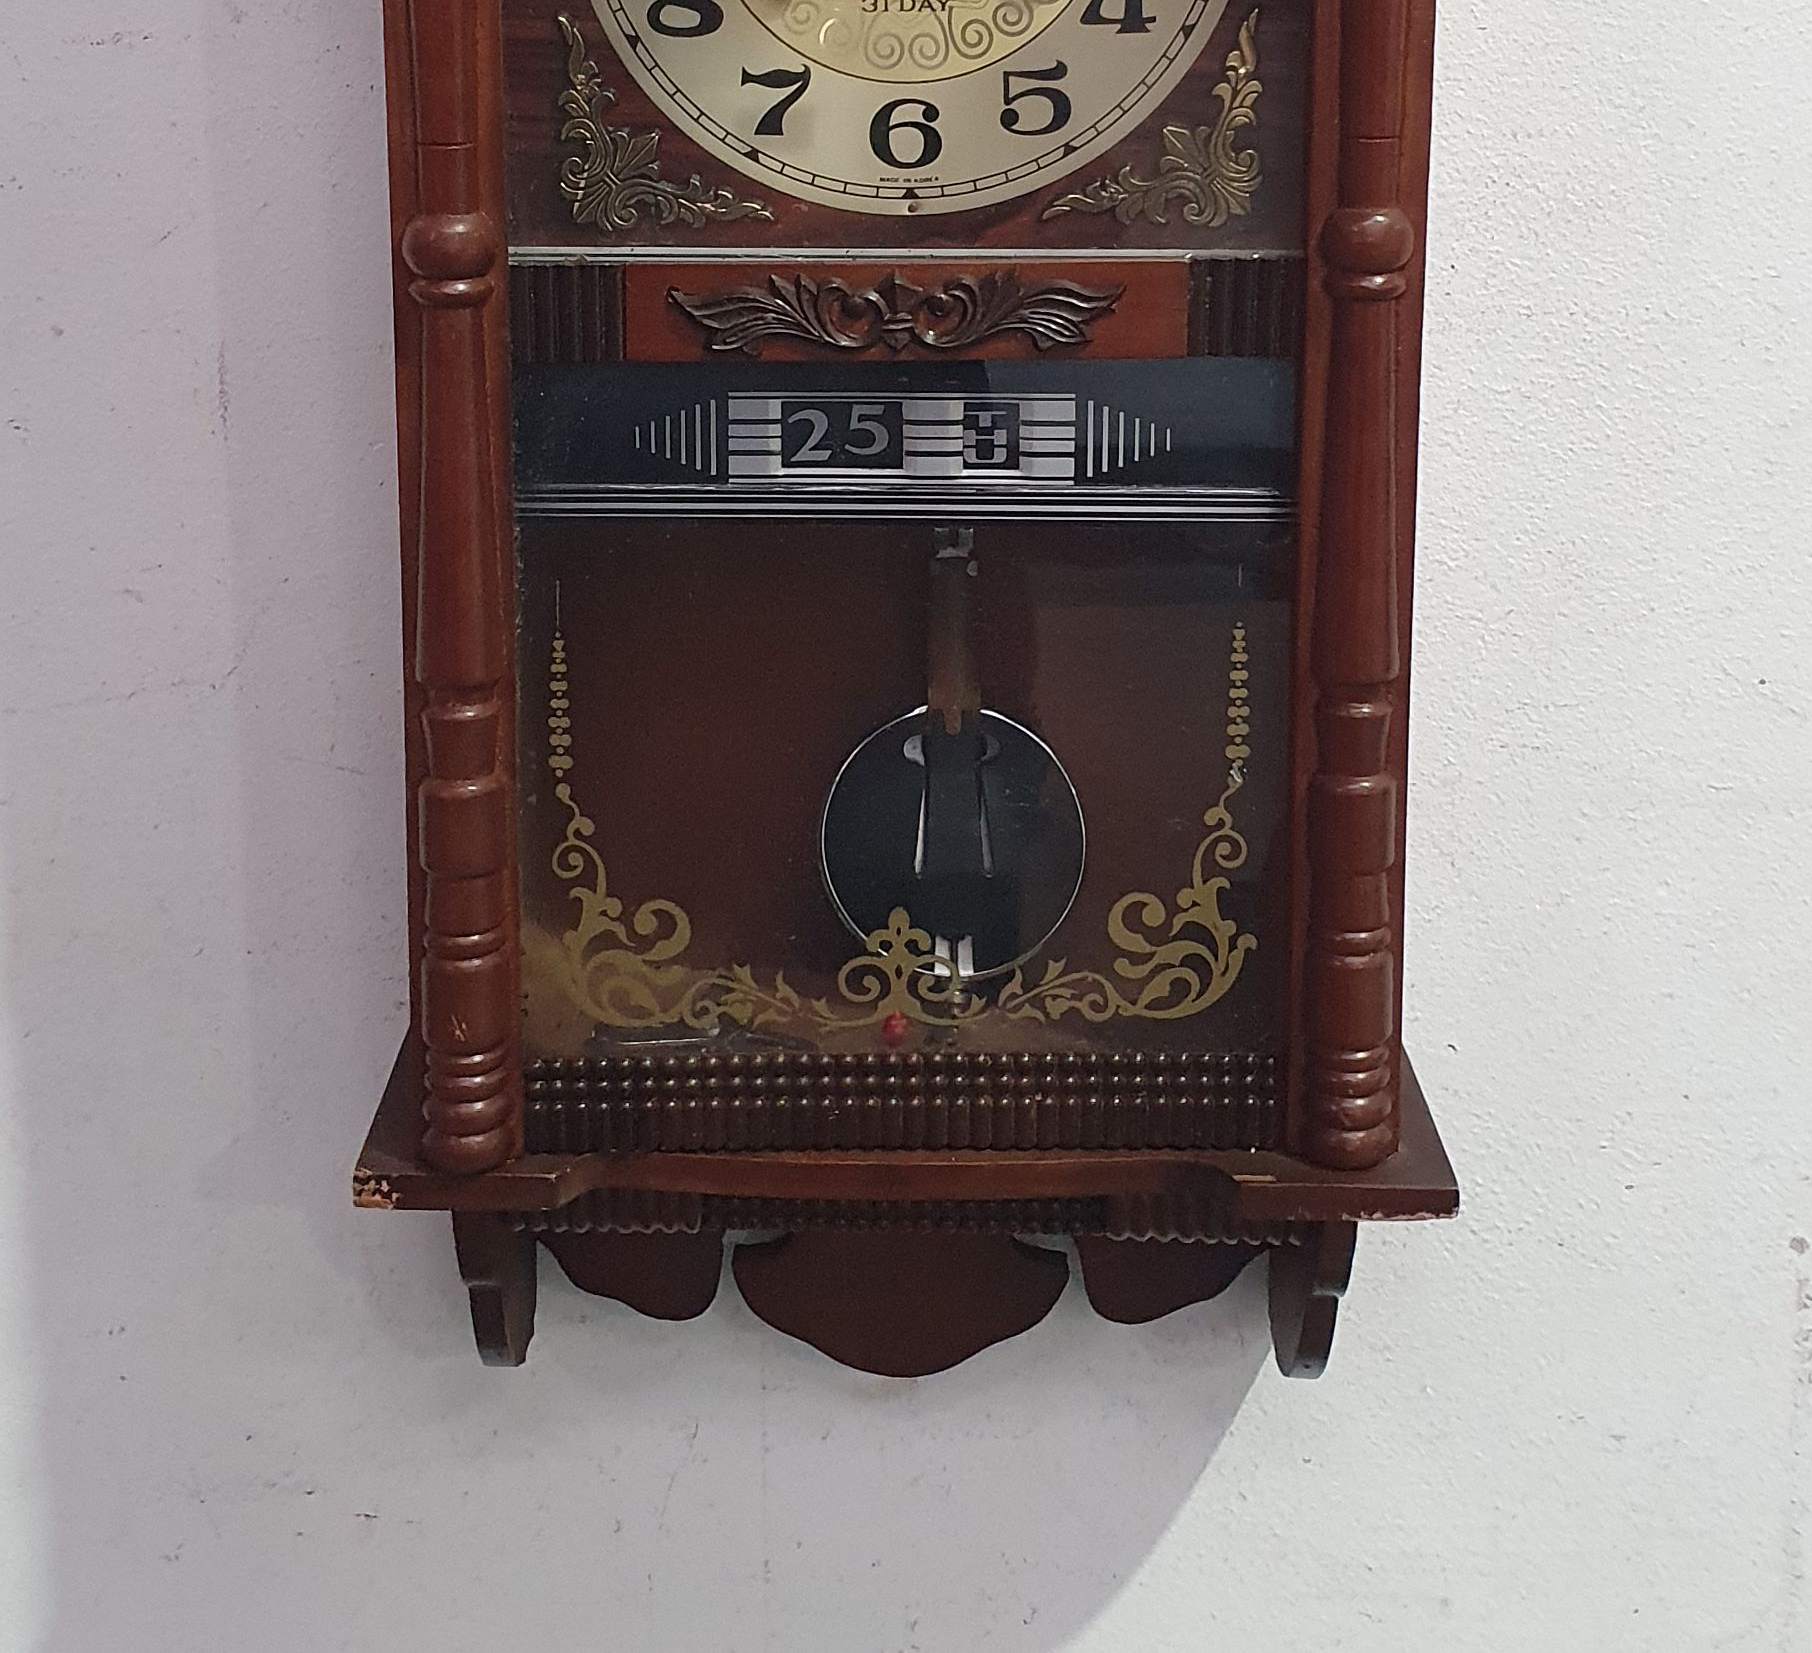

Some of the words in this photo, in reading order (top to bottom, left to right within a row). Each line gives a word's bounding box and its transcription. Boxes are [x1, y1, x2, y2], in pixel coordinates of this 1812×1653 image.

[741, 63, 811, 136] 7
[1000, 59, 1072, 136] 5
[869, 99, 943, 170] 6
[787, 404, 890, 462] 25
